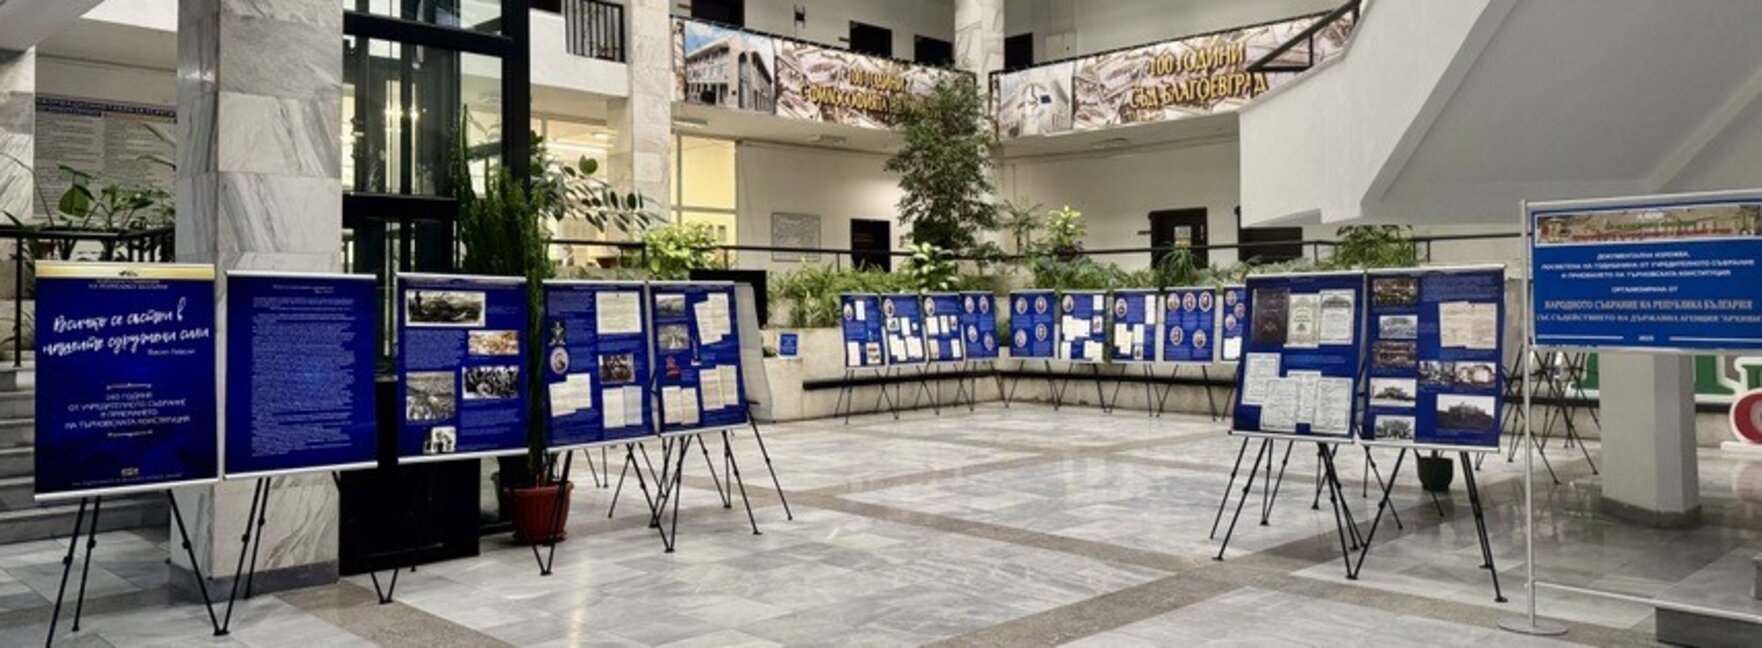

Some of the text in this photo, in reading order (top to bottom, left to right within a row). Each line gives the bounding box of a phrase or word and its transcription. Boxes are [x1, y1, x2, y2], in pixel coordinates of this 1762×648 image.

[1148, 42, 1247, 76] 100 ГОДИНИ
[1129, 86, 1160, 109] СЪД
[1639, 261, 1649, 269] ОТ
[111, 314, 123, 326] се
[177, 296, 187, 321] в
[1544, 299, 1753, 311] НАРОДНОТО СЪБРАНИЕ НА РЕПУБЛИКА БЪЛГАРИЯ
